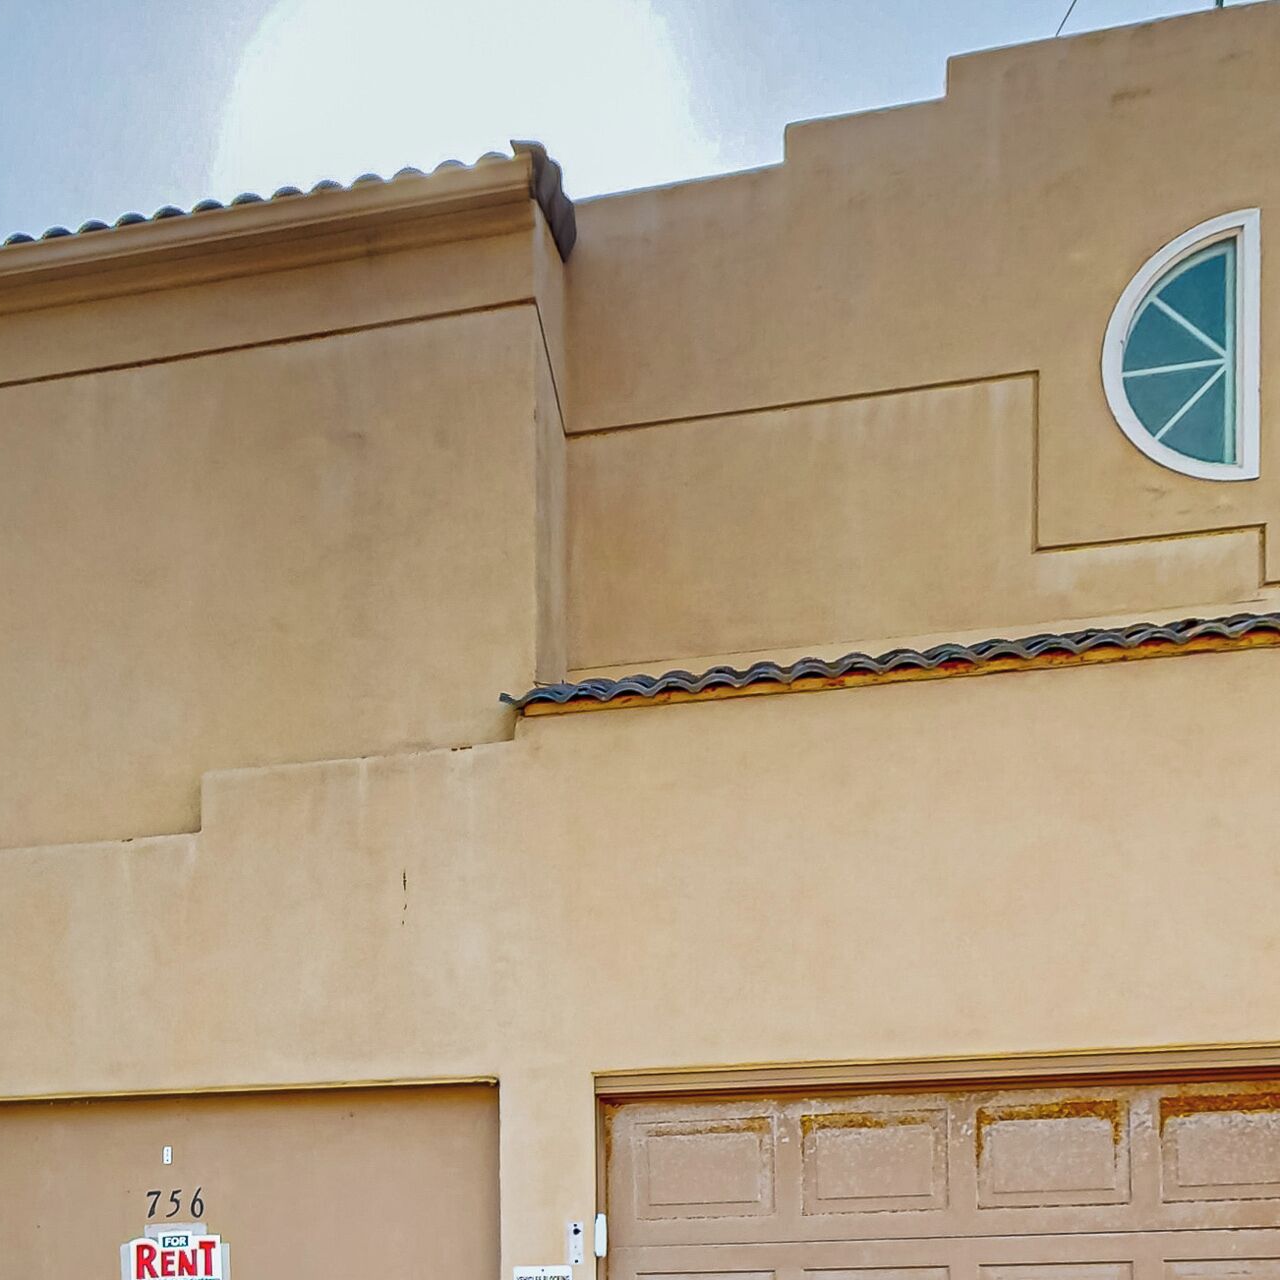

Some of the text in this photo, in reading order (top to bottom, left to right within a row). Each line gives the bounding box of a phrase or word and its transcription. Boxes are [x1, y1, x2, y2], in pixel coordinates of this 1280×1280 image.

[146, 1187, 204, 1218] 756
[165, 1237, 187, 1247] FOR
[136, 1241, 216, 1279] RENT
